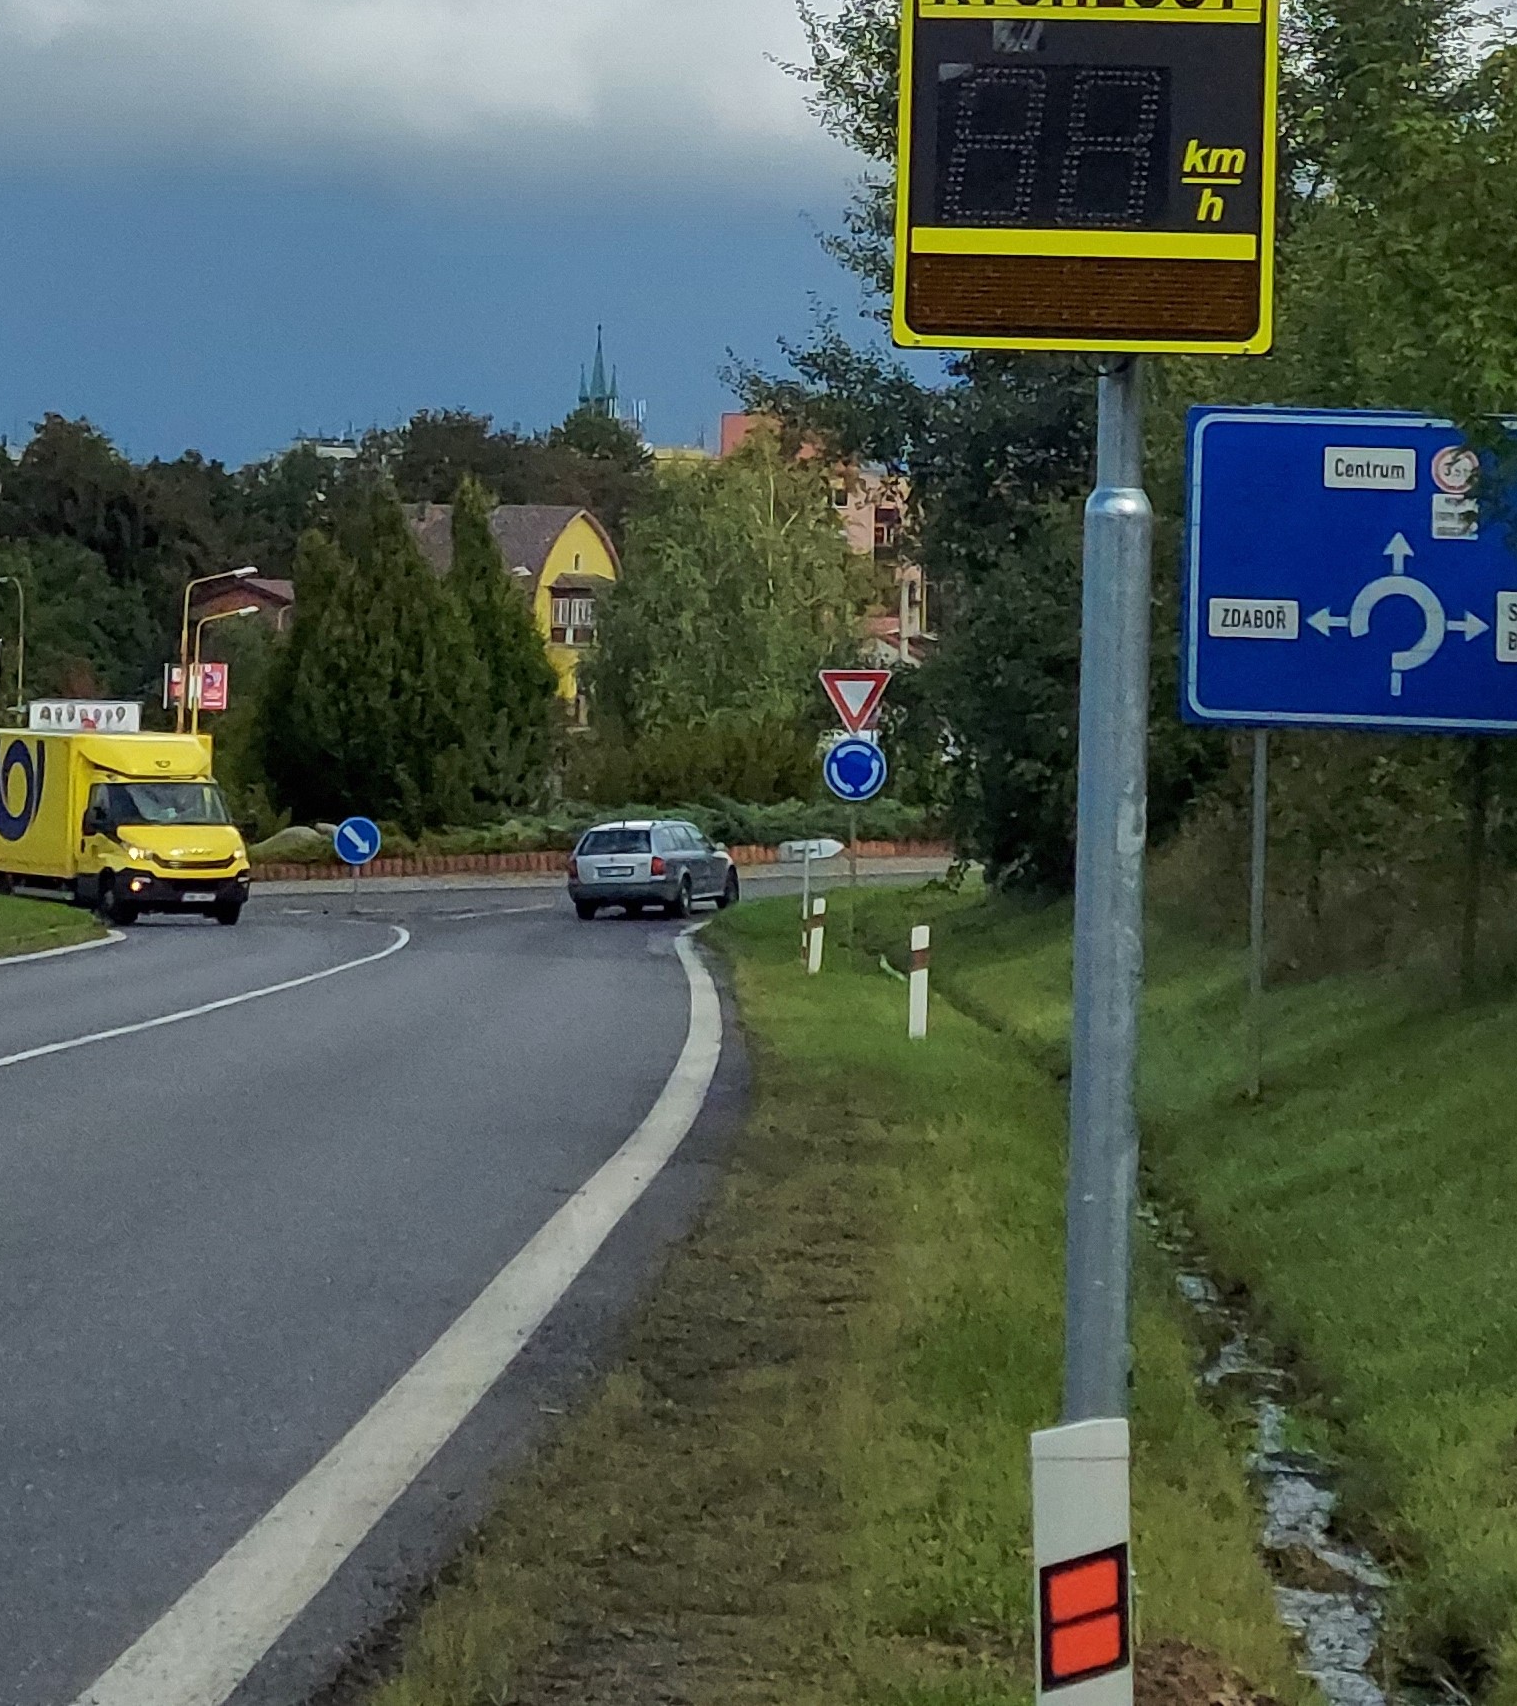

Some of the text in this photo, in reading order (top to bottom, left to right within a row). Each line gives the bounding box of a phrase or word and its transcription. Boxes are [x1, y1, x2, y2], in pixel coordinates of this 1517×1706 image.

[1183, 138, 1246, 174] km
[1196, 187, 1224, 222] h
[1334, 457, 1406, 480] Centrum
[1220, 605, 1287, 630] ZDABOŘ
